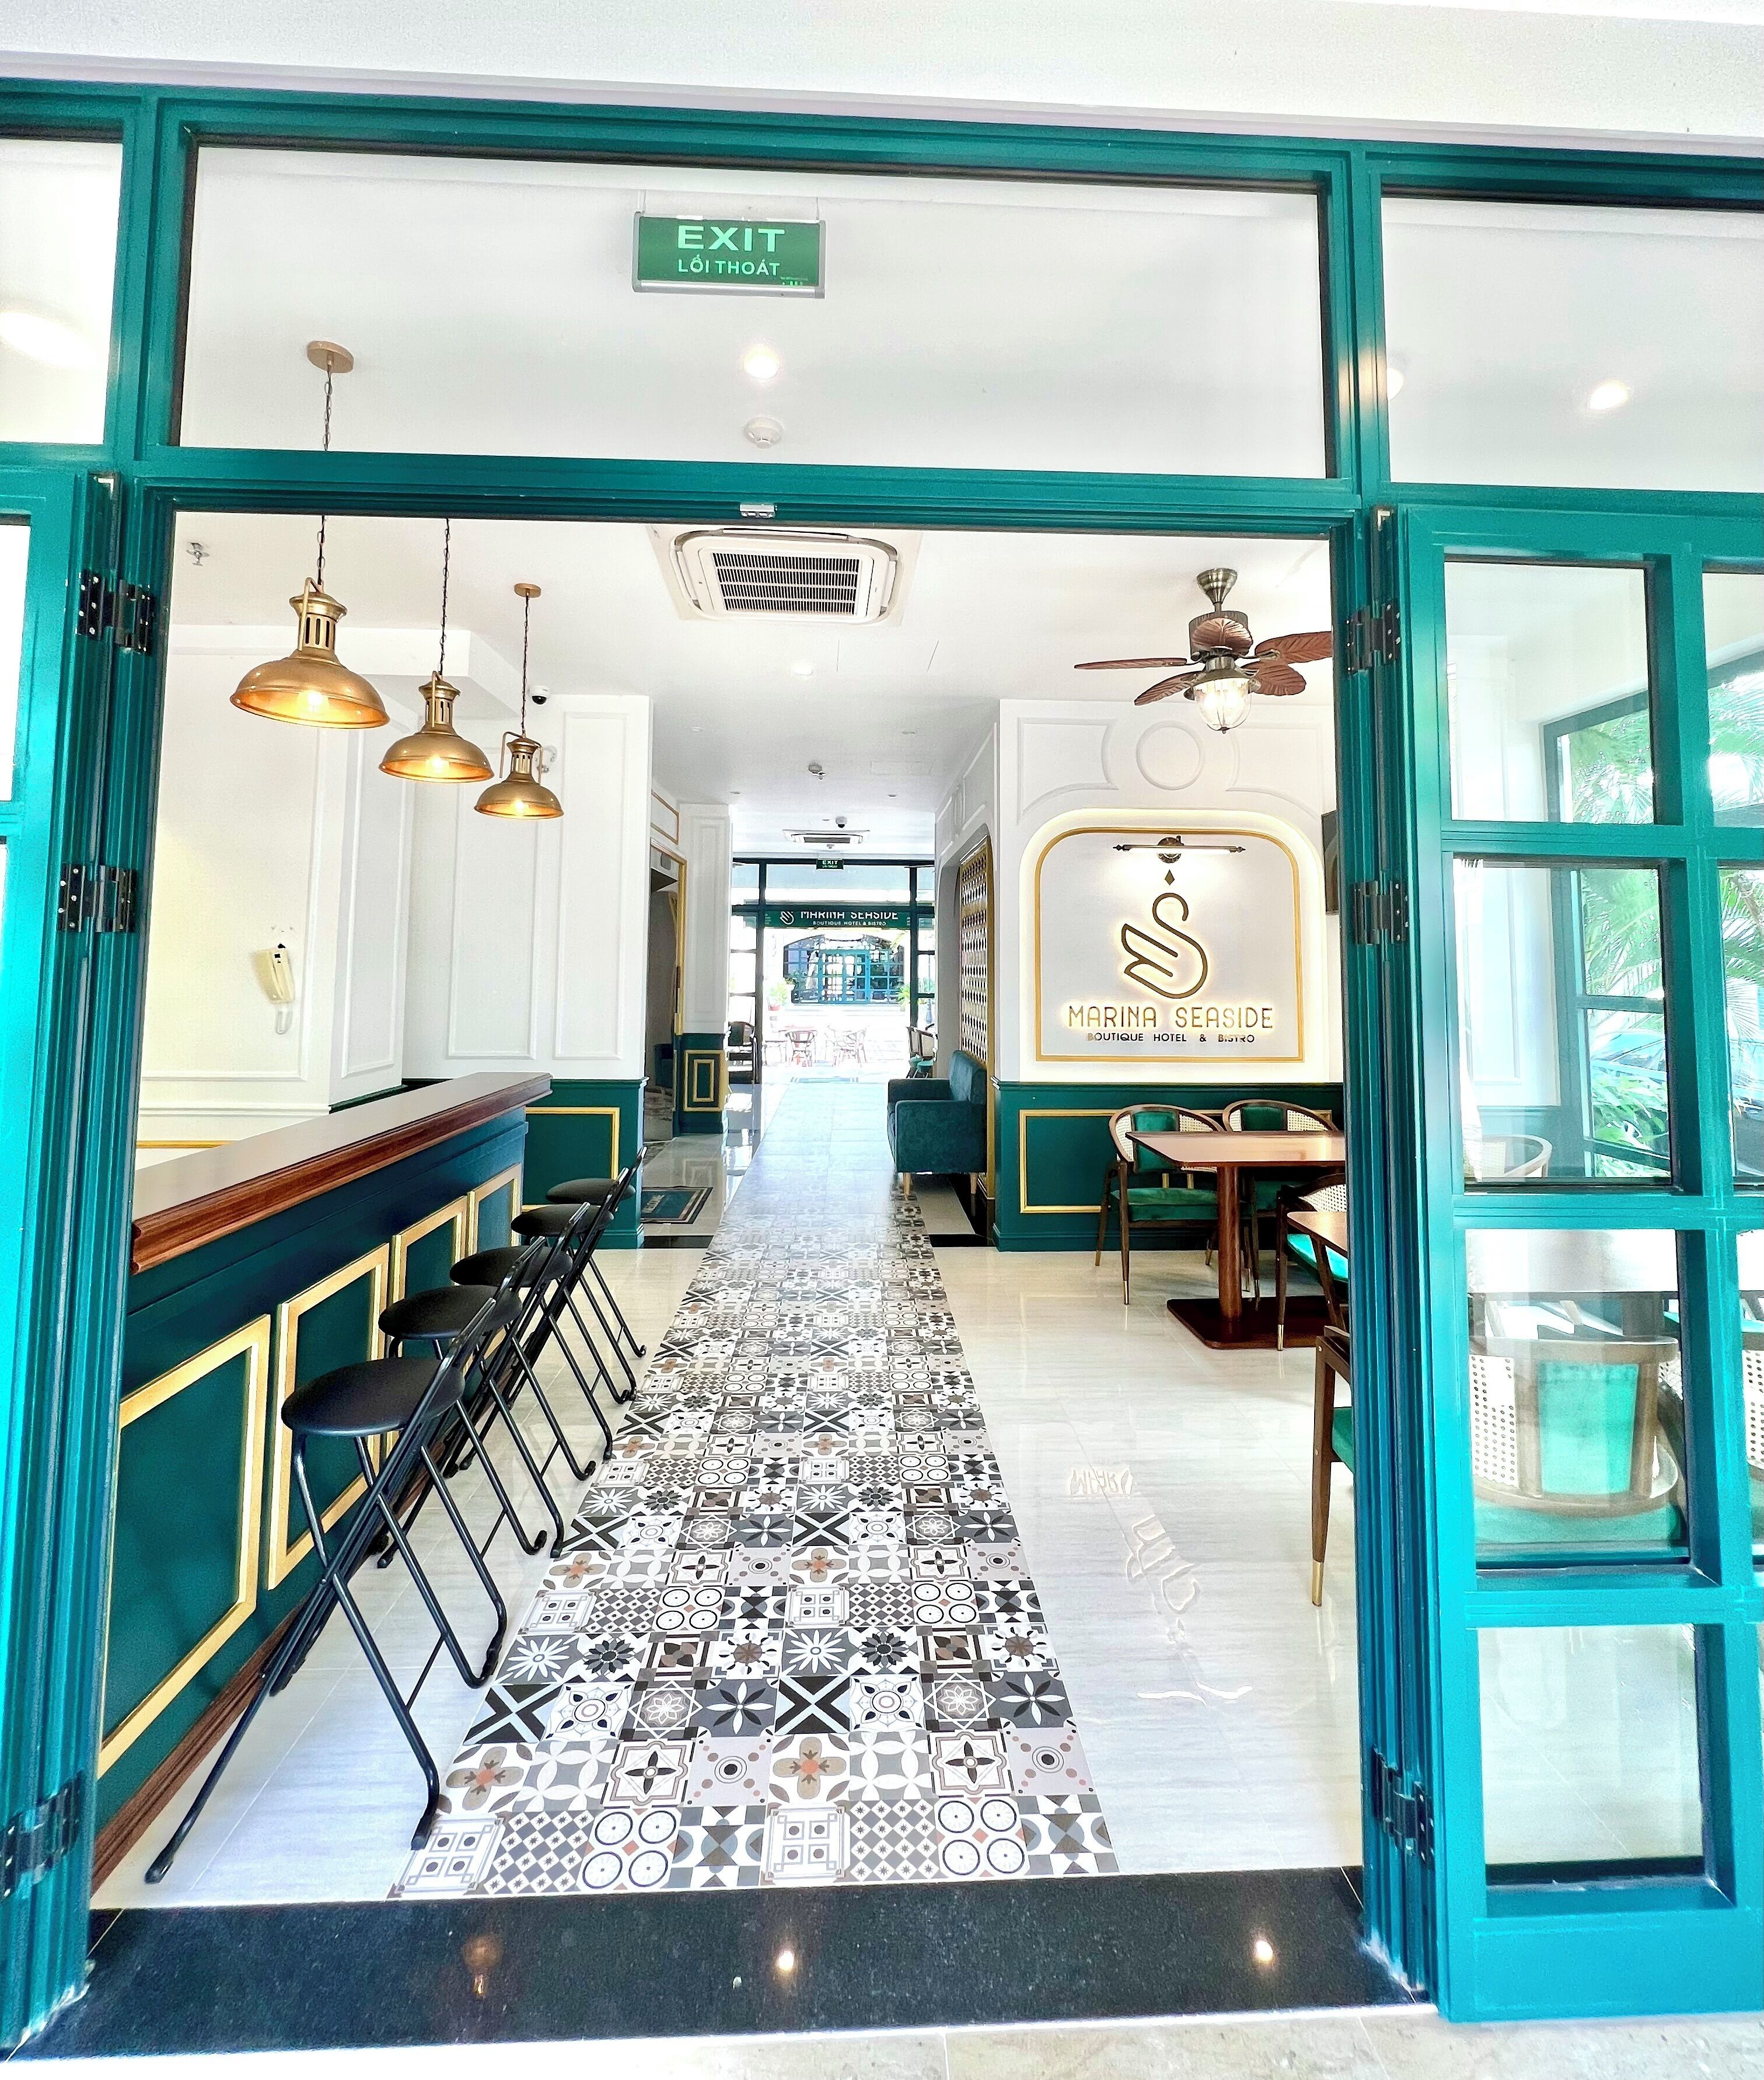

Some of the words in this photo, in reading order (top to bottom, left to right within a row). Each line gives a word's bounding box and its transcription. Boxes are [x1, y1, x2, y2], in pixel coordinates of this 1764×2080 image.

[677, 225, 785, 253] EXIT
[714, 259, 781, 277] THOÁT
[1068, 1005, 1157, 1028] MARINA
[1175, 1006, 1273, 1029] SEASIDE
[1087, 1032, 1144, 1042] BOUTIQUE
[1153, 1033, 1187, 1042] HOTEL
[1199, 1034, 1207, 1043] &
[1218, 1034, 1255, 1044] BISTRO
